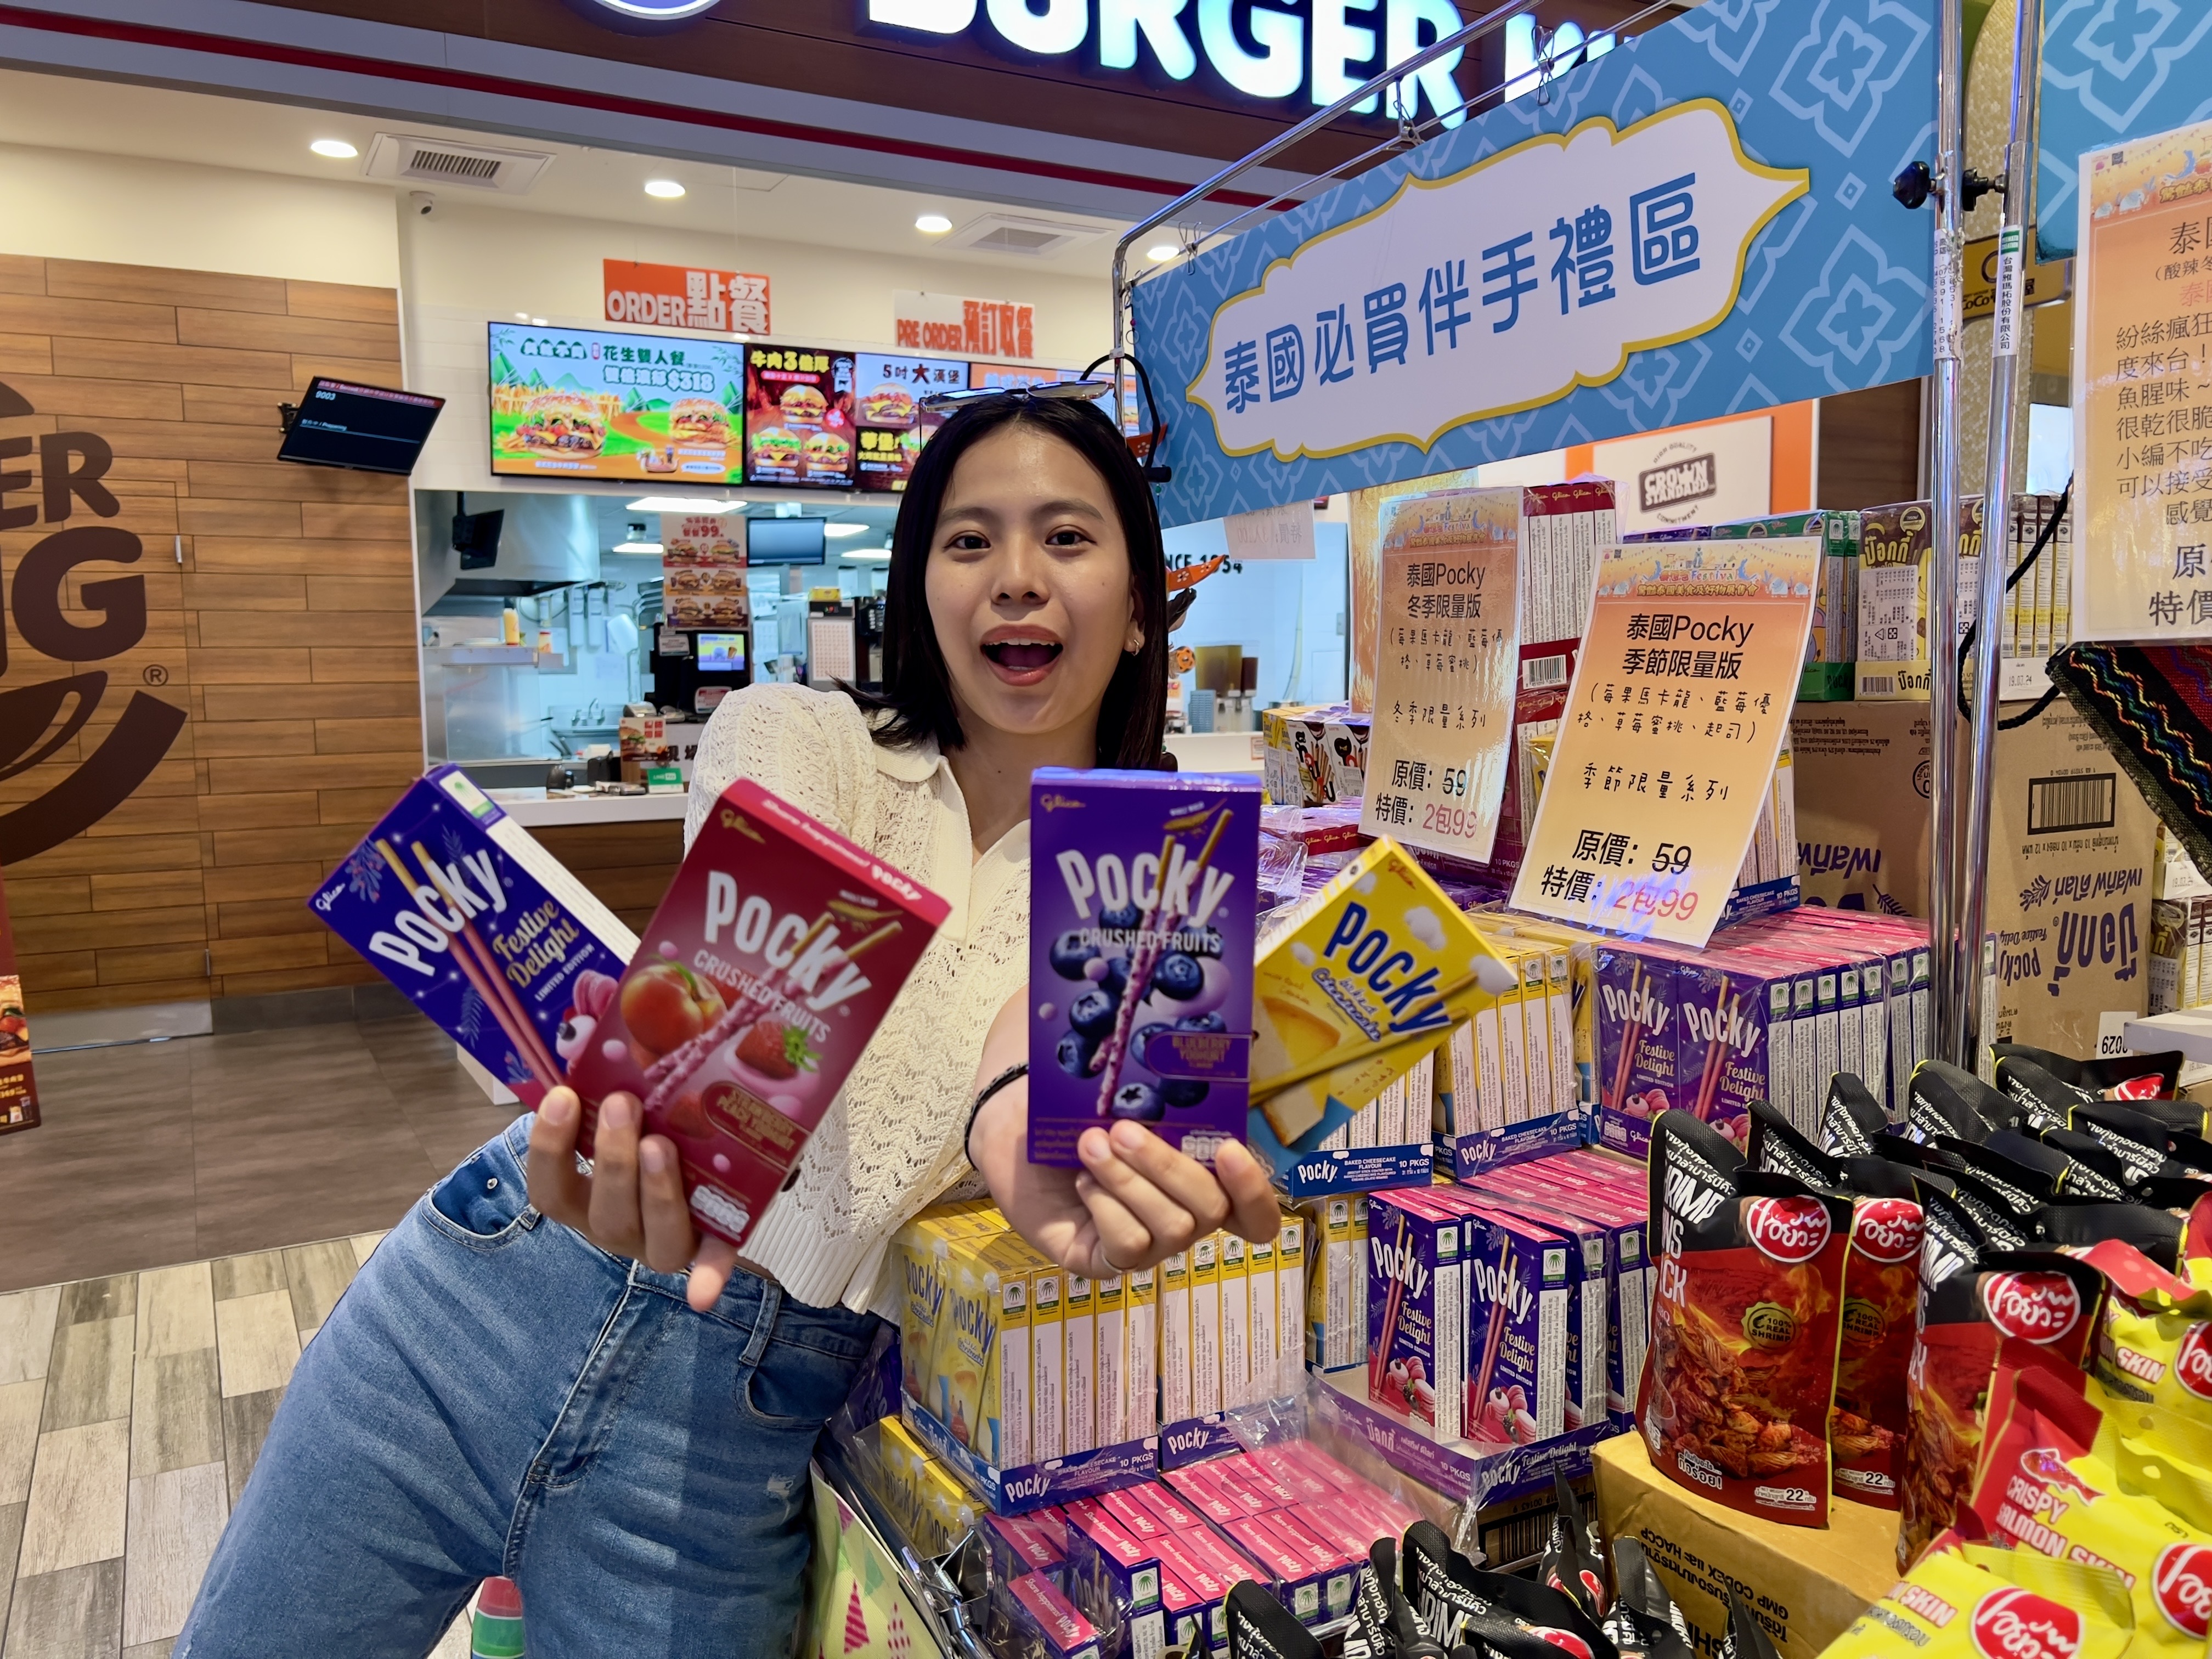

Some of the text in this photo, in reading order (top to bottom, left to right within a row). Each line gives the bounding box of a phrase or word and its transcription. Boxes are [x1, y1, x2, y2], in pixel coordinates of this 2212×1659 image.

[607, 271, 769, 334] ORDER 點餐
[1224, 171, 1701, 415] 泰國必買伴手禮區
[2000, 257, 2013, 349] 台灣雅瑪拓股份有限公司
[897, 300, 1034, 359] PRE ORDER 預訂取餐
[603, 345, 686, 366] 花生雙人餐
[751, 350, 830, 373] 牛肉3倍厚
[883, 364, 960, 384] 5吋大漢堡
[2116, 405, 2212, 441] 很乾很脆
[1669, 442, 1697, 453] QUALITY
[2116, 437, 2212, 470] 小編不吃
[1644, 459, 1707, 493] CROWN
[2116, 469, 2212, 499] 可以接受
[1552, 489, 1592, 501] Glico Glico
[1645, 479, 1709, 506] STANDARD
[1657, 504, 1699, 523] COMMITMENT
[2165, 499, 2212, 525] 感覺
[1865, 531, 1915, 566] ป๊อกกี้
[2172, 543, 2212, 580] 原
[1407, 561, 1486, 588] 泰國Pocky
[1691, 570, 1737, 582] Festival
[1408, 593, 1481, 620] 冬季限量版
[1626, 613, 1754, 648] 泰國Pocky
[1621, 648, 1744, 681] 季節限量版
[1392, 700, 1486, 730] 冬季限量系列
[1442, 767, 1467, 796] 59
[1583, 761, 1729, 803] 季節限量系列
[1040, 793, 1086, 812] Glico
[720, 809, 765, 844] Glico
[1422, 803, 1477, 839] 2包99
[1502, 859, 1520, 868] PKGS
[1651, 842, 1692, 876] 59
[1056, 843, 1235, 928] Pocky
[1387, 859, 1417, 890] Glico
[315, 884, 346, 912] Glico
[1612, 880, 1699, 922] 2包99
[369, 849, 507, 977] Pocky
[493, 900, 560, 961] Festive
[704, 870, 872, 1014] Pocky
[1080, 927, 1222, 953] CRUSHED FRUITS
[2022, 928, 2047, 943] Festive
[506, 919, 580, 989] Delight
[2047, 902, 2138, 997] ป๊อกกี้
[534, 943, 595, 1002] LIMITED EDITION
[1322, 900, 1452, 1034] Pocky
[693, 949, 831, 1043] CRUSHED FRUITS
[1602, 984, 1671, 1036] Pocky
[1683, 1002, 1761, 1058] Pocky
[1634, 1052, 1675, 1078] Delight
[1639, 1039, 1675, 1062] Festive
[1636, 1074, 1674, 1088] LIMITED EDITION
[1725, 1061, 1766, 1085] Festive
[1719, 1075, 1764, 1102] Delight
[1502, 1123, 1577, 1142] BAKED CHEESECAKE 10 PKGS
[1514, 1134, 1536, 1144] FLAVOUR
[1398, 1160, 1408, 1169] 10
[1409, 1158, 1430, 1167] PKGS
[1461, 1139, 1497, 1165] Pocky
[1297, 1160, 1338, 1184] Pocky
[1370, 1236, 1429, 1299] Pocky
[1474, 1258, 1533, 1324] Pocky
[1401, 1300, 1432, 1330] Festive
[1766, 1324, 1791, 1335] REAL
[1767, 1317, 1792, 1328] 100%
[1854, 1319, 1880, 1333] REAL
[1397, 1315, 1431, 1346] Delight
[1503, 1325, 1536, 1356] Festive
[1751, 1329, 1792, 1343] SHRIMP
[1499, 1340, 1535, 1374] Delight
[2117, 1347, 2166, 1384] SKIN
[1499, 1364, 1533, 1386] LIMITED EDITION
[1167, 1427, 1210, 1455] Pocky
[1521, 1441, 1577, 1467] Festive Delight
[1132, 1452, 1154, 1464] PKGS
[1441, 1461, 1471, 1482] 10 PKGS
[1005, 1474, 1051, 1503] Pocky
[1865, 1472, 1883, 1485] 22
[1786, 1489, 1804, 1502] 22
[2007, 1475, 2068, 1523] CRISPY
[1640, 1527, 1683, 1560] HACCP
[1996, 1502, 2067, 1558] SALMON
[1277, 1555, 1302, 1573] Pocky
[1195, 1573, 1220, 1592] Pocky
[1024, 1577, 1039, 1593] Share
[1055, 1615, 1081, 1638] Pocky
[1756, 1595, 1789, 1620] GMP
[1899, 1584, 1958, 1629] SKIN
